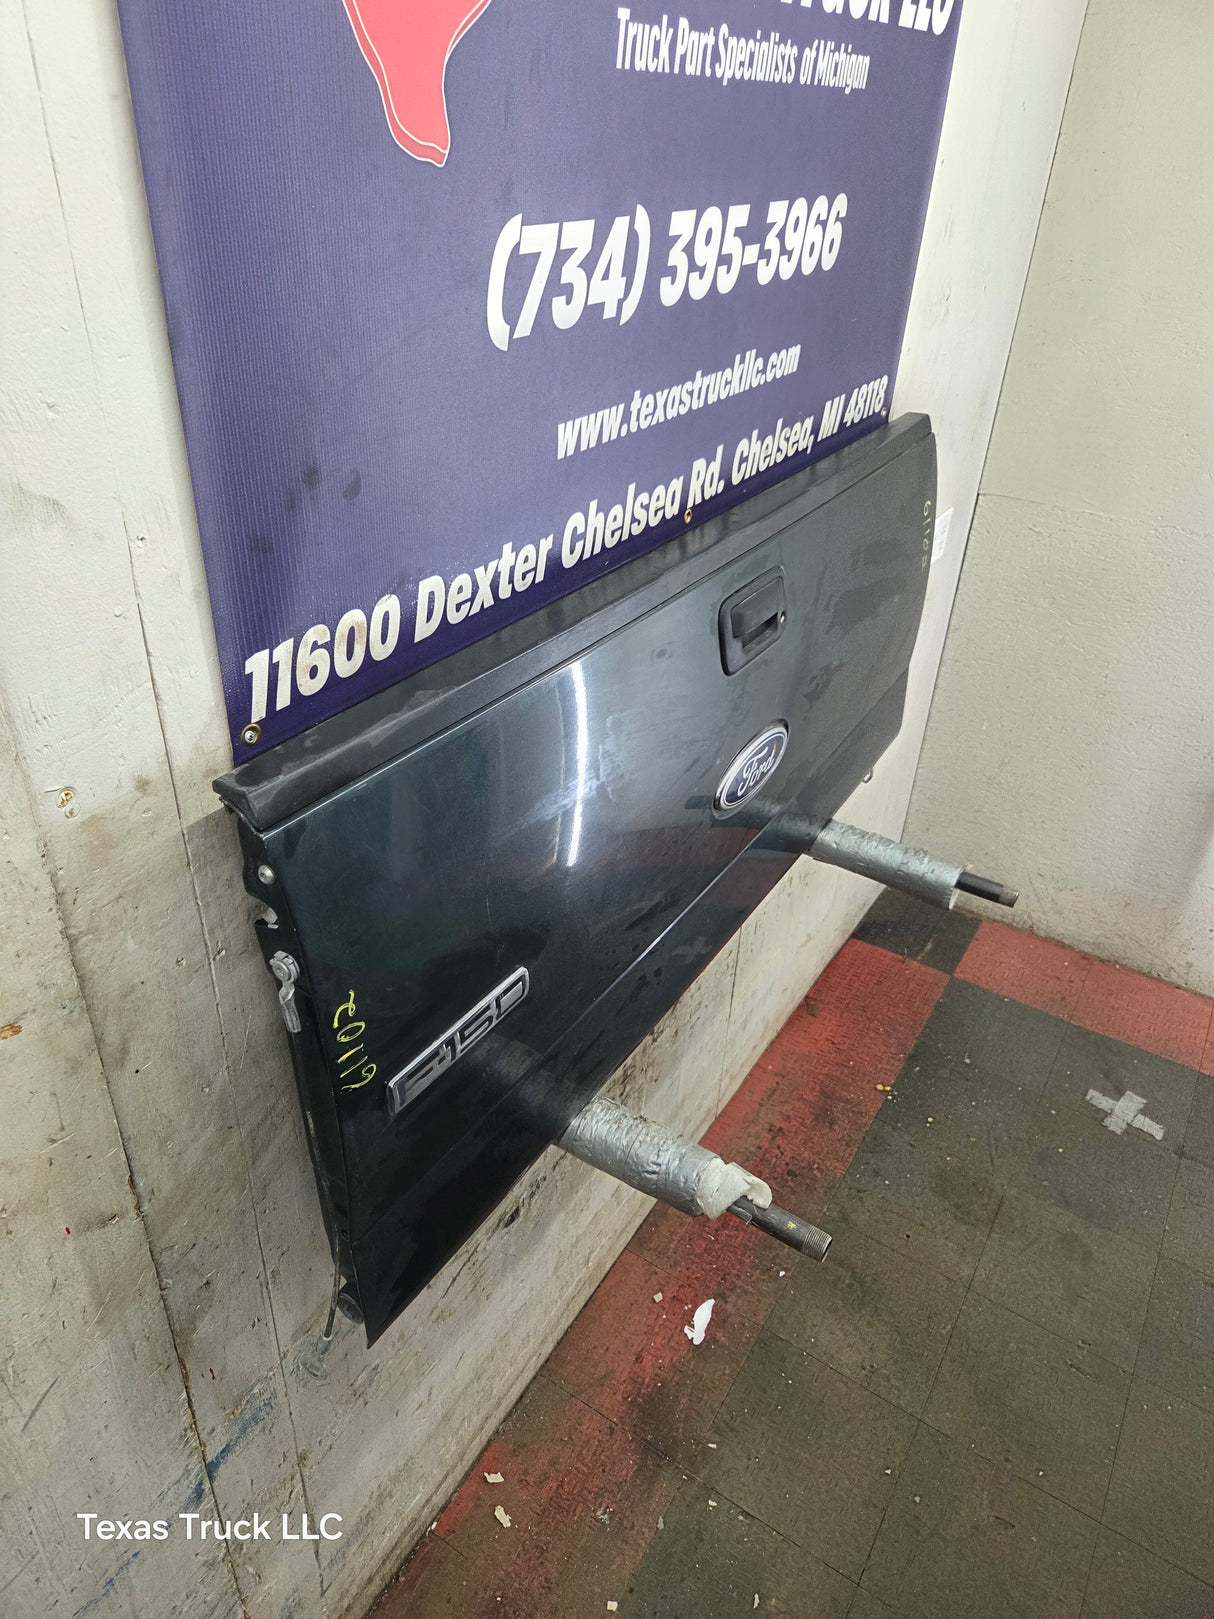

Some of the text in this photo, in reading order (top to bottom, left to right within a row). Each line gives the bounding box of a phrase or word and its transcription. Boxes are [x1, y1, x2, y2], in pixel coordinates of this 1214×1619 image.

[615, 7, 674, 74] Truck
[673, 17, 715, 77] Part
[714, 23, 799, 86] Specialists
[799, 40, 819, 85] of
[813, 39, 871, 95] Michigan
[486, 193, 848, 351] (734) 395-3966
[557, 343, 801, 460] www.texastruckllc.com
[244, 374, 889, 724] 11600 Dexter Chelsea Rd. Chelsea, MI 48118
[736, 742, 777, 797] Ford
